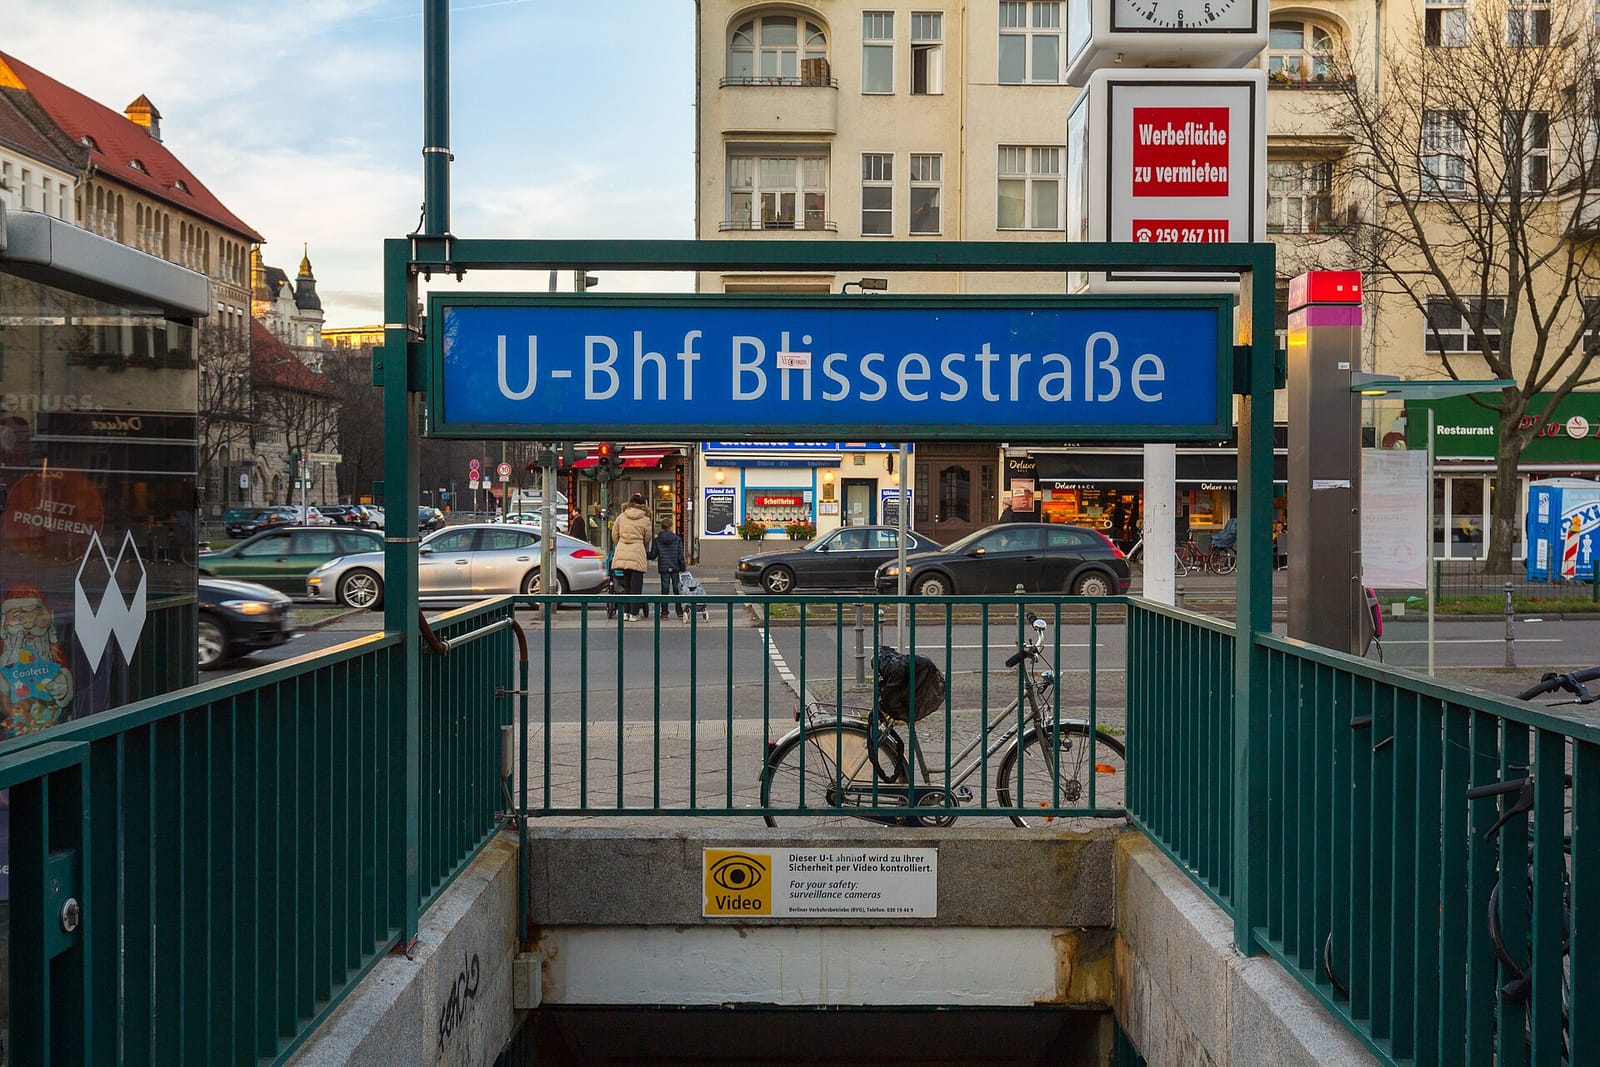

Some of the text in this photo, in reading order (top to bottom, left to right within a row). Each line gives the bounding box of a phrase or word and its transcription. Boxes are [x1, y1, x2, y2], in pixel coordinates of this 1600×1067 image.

[1152, 2, 1158, 12] 7
[1204, 3, 1210, 13] 5
[1177, 10, 1184, 19] 6
[1139, 122, 1226, 145] Werbefläche
[1135, 159, 1228, 183] zu vermieten
[1156, 229, 1225, 242] 259 267 111
[497, 330, 1166, 402] U-Bhf Blissestraße
[1436, 425, 1494, 435] Restaurant
[1009, 459, 1036, 470] Deluxe
[36, 499, 76, 516] JETZT
[13, 511, 94, 536] PROBIEREN
[12, 666, 49, 679] Confetti
[789, 854, 817, 862] Dieser
[868, 854, 888, 862] wird
[903, 855, 924, 863] Ihrer
[789, 863, 933, 873] Sicherheit per Video kontrolliert.
[790, 880, 859, 890] For your safety:
[789, 890, 881, 899] surveillance cameras
[715, 895, 762, 910] Video
